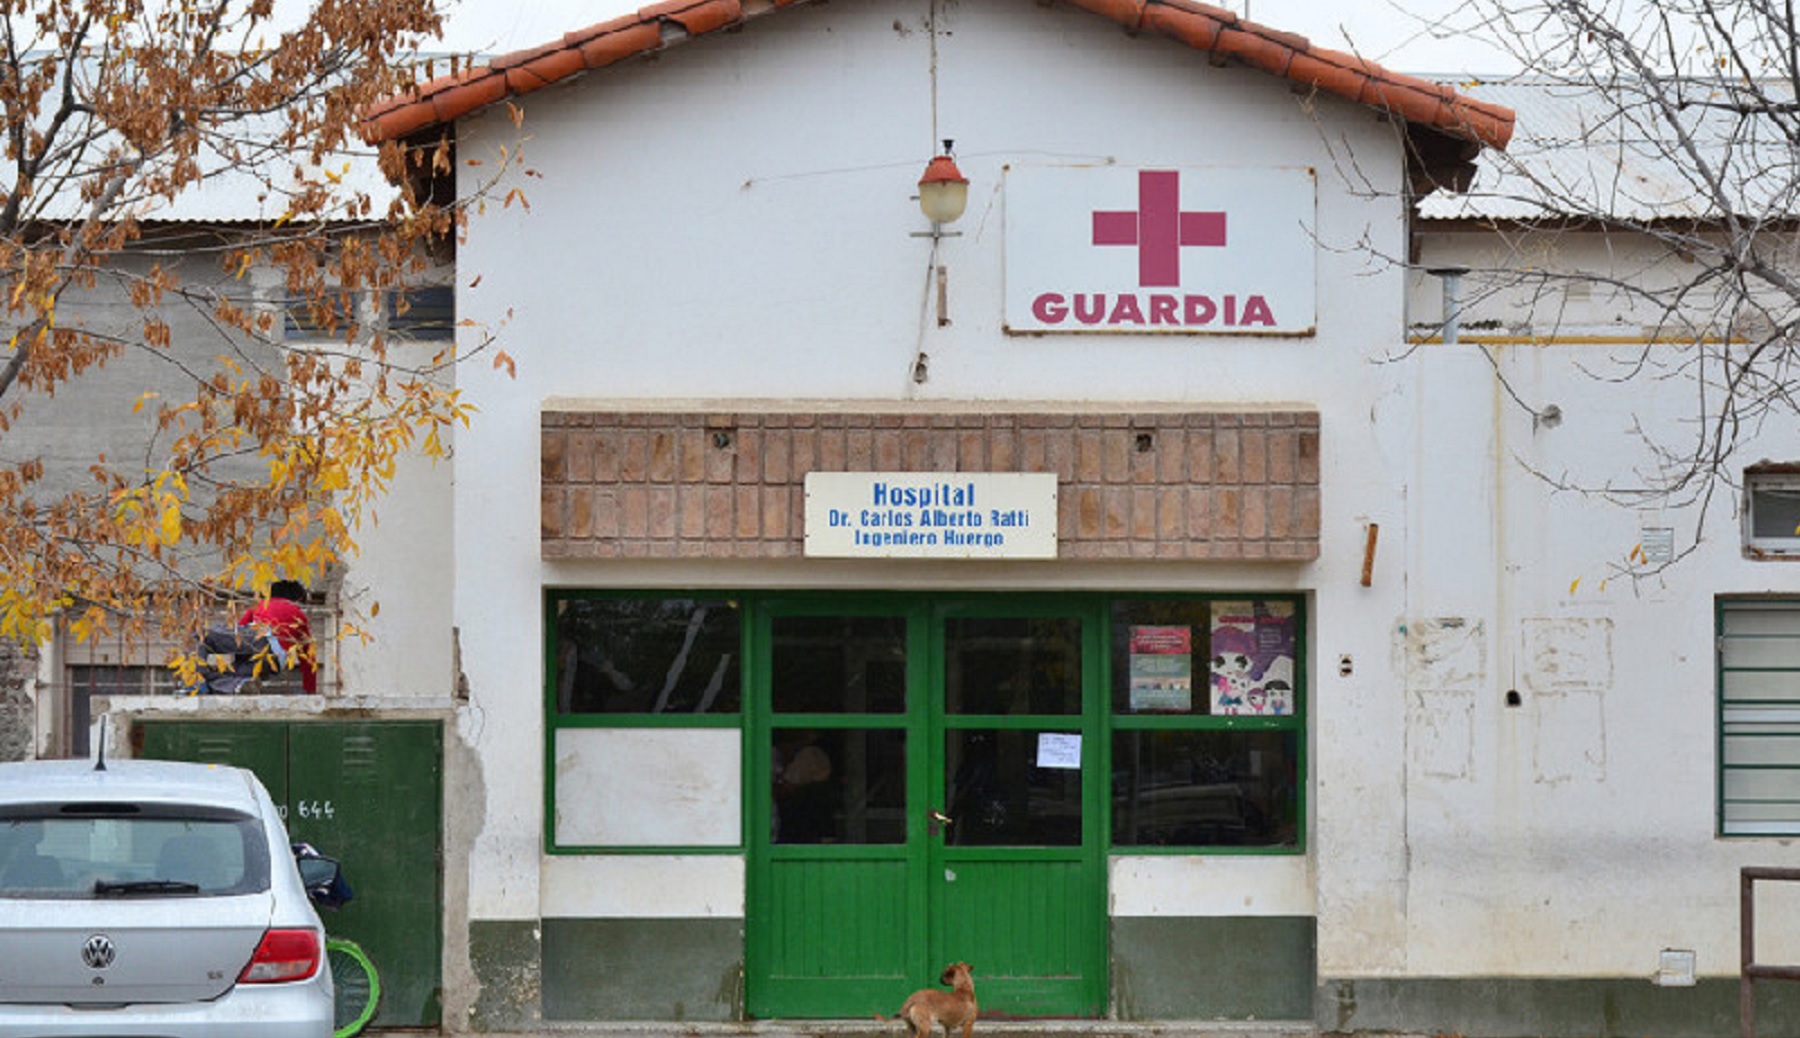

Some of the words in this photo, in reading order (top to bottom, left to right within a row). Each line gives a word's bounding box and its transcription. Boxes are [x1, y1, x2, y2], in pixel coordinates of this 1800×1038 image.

[1031, 292, 1276, 326] GUARDIA
[873, 483, 975, 509] Hospital
[829, 509, 851, 527] Dr.
[860, 509, 913, 527] Carlos
[920, 509, 982, 527] Alberto
[854, 529, 937, 547] Ingeniero
[943, 530, 1004, 547] Huergo
